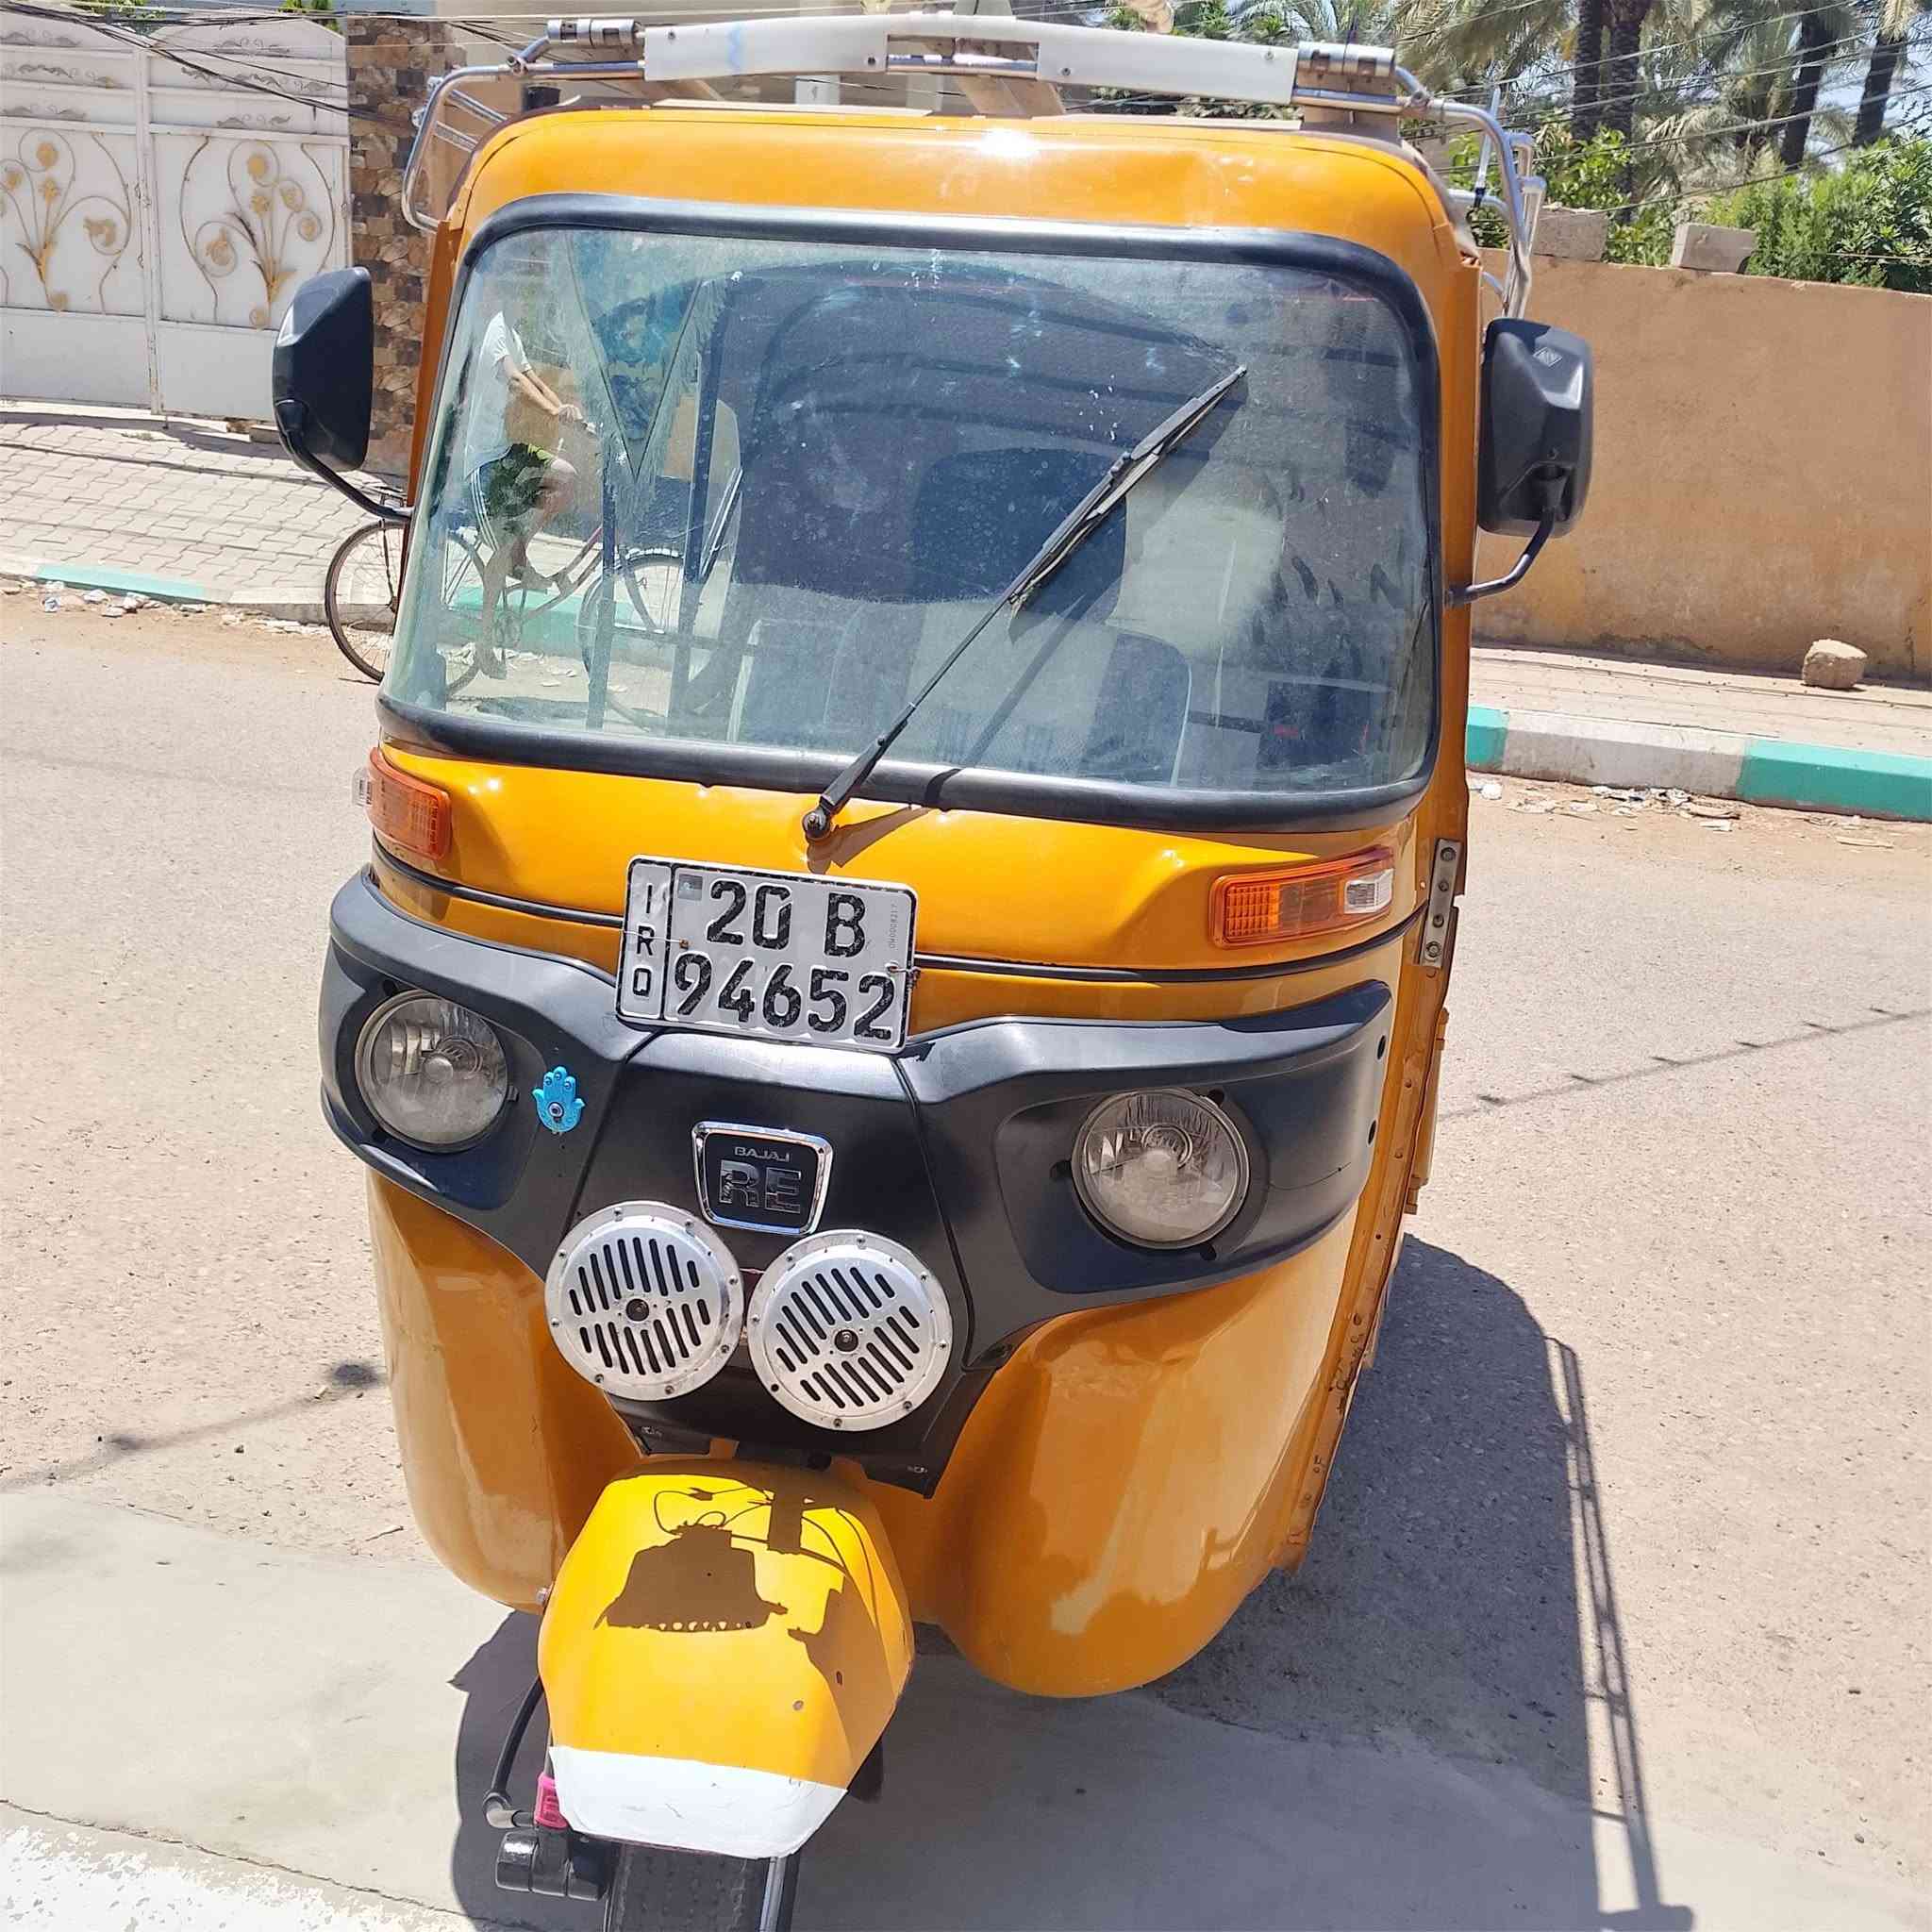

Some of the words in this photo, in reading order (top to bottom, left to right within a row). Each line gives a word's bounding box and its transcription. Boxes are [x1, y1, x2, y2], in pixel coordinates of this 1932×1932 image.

[633, 884, 655, 997] IRQ
[707, 879, 791, 950] 20
[824, 892, 866, 957] B
[675, 953, 895, 1040] 94652
[719, 1159, 802, 1214] RE
[734, 1146, 791, 1162] BAJAJ
